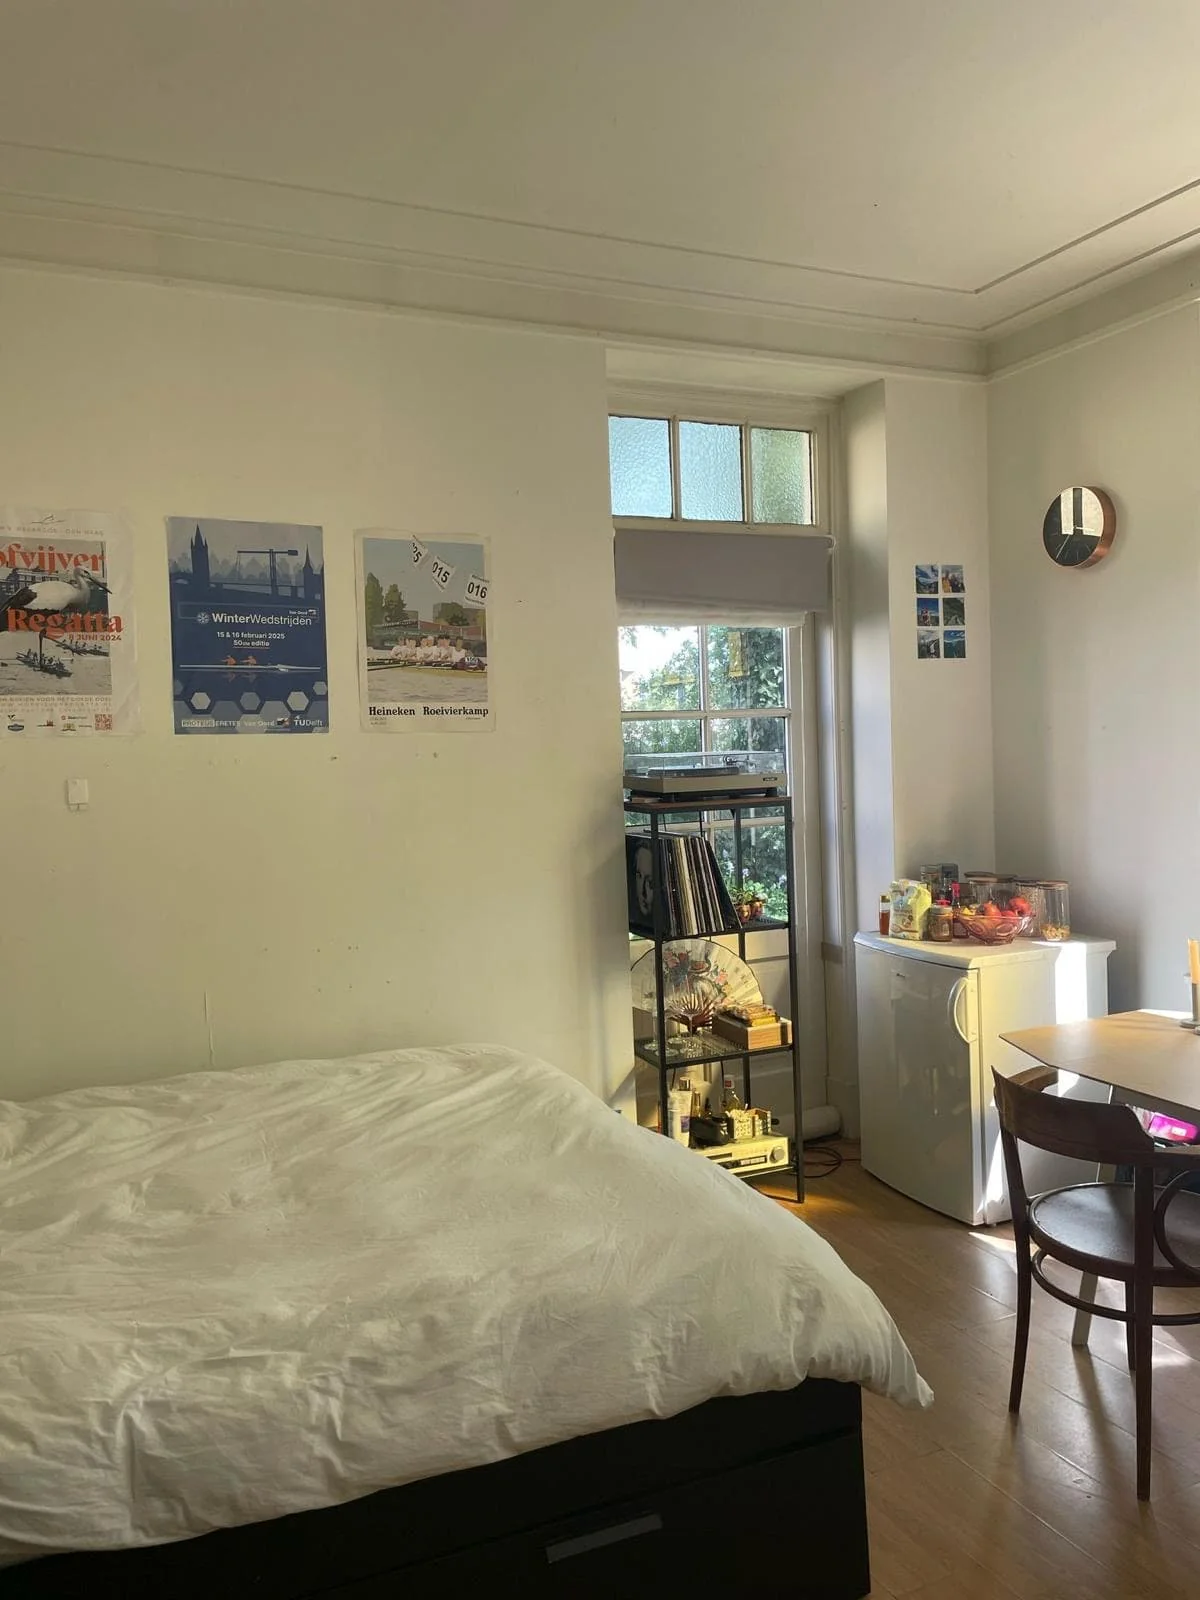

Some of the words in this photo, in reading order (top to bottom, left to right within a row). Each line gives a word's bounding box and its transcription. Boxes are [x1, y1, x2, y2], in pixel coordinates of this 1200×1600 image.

[432, 562, 450, 583] 015
[467, 582, 488, 599] 016
[7, 607, 124, 639] Regatta
[212, 612, 312, 627] WinterWedstrijden
[368, 706, 416, 716] Heineken
[423, 706, 489, 718] Roeivierkamp
